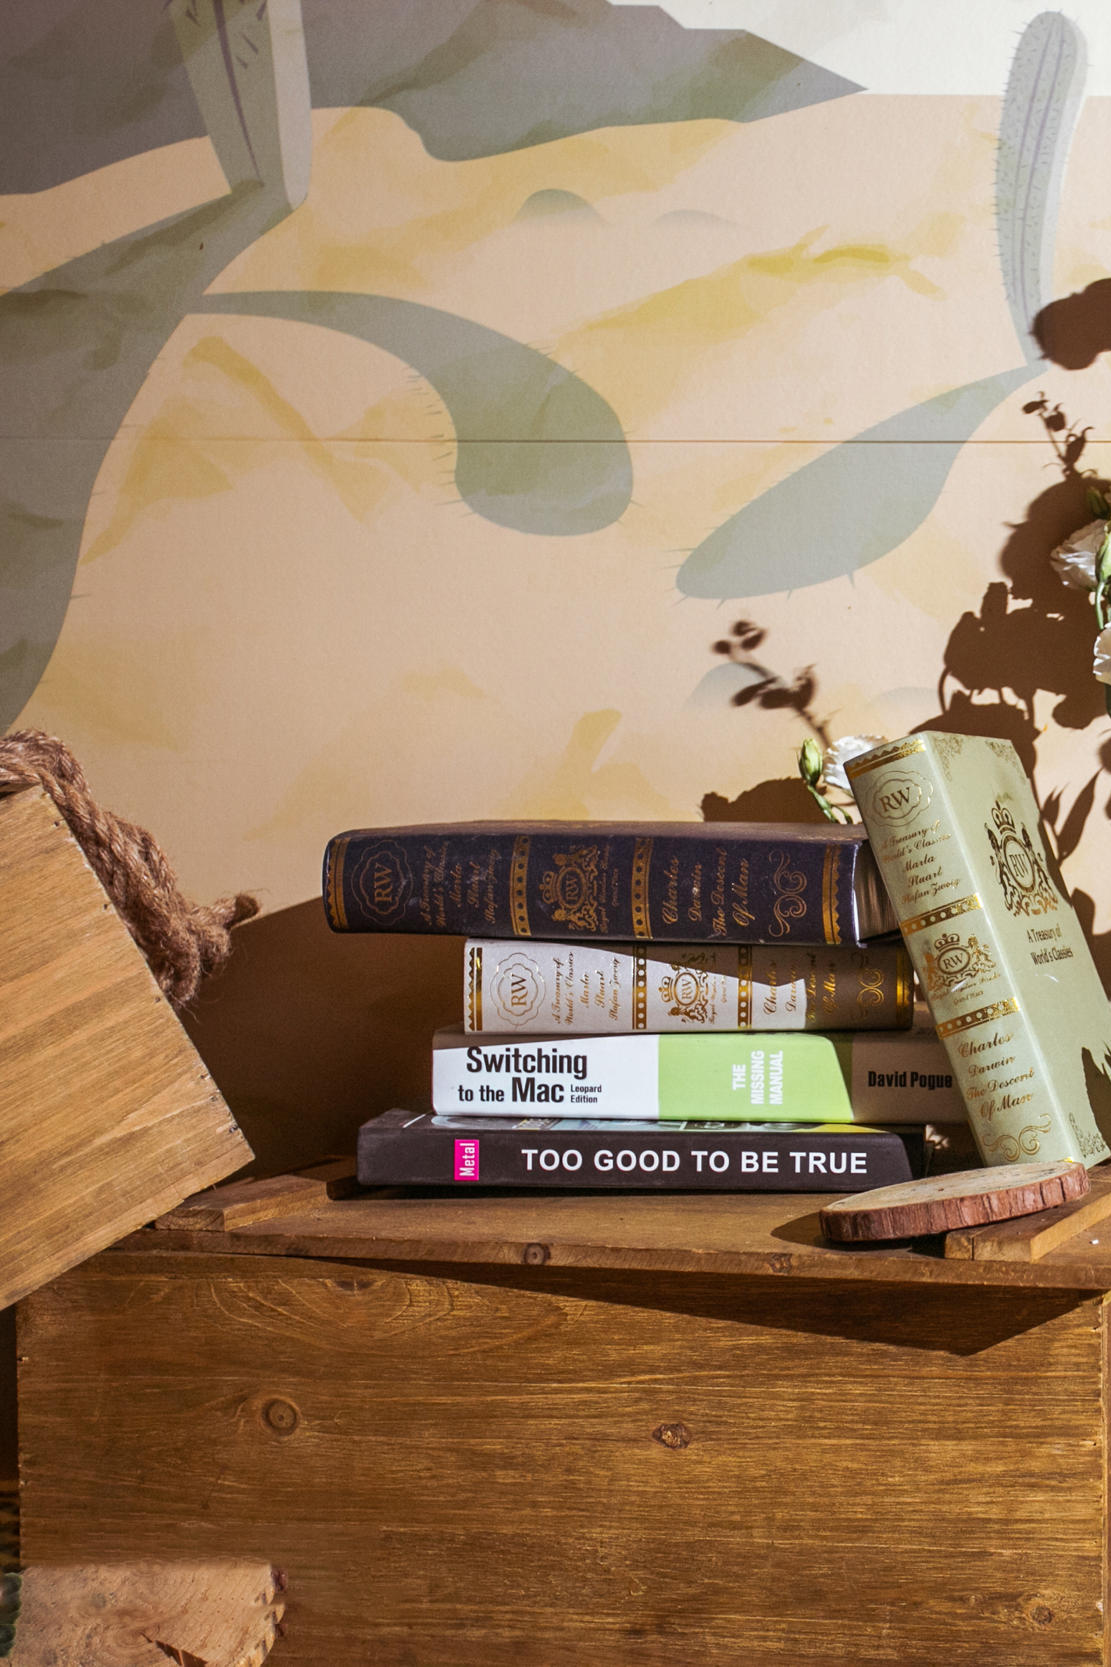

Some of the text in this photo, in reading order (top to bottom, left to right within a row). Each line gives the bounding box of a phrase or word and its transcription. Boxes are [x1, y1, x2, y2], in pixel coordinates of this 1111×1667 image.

[879, 787, 911, 814] RW
[890, 827, 927, 847] Treasury
[711, 848, 727, 905] Descent
[1010, 849, 1029, 878] RW
[373, 862, 394, 904] RW
[566, 875, 578, 900] RW
[662, 856, 678, 924] Charles
[688, 863, 702, 922] Darwin
[732, 858, 755, 926] Of Man
[713, 907, 727, 936] The
[942, 953, 963, 969] RW
[511, 974, 529, 1007] RW
[681, 979, 692, 1000] RW
[763, 960, 777, 1015] Charles
[958, 1032, 1013, 1057] Charles
[466, 1046, 587, 1079] Switching
[732, 1064, 746, 1090] THE
[751, 1050, 764, 1104] MISSING
[968, 1056, 1016, 1078] Darwin
[458, 1077, 564, 1102] to the Mac
[570, 1085, 602, 1094] Leopard
[770, 1050, 783, 1105] MANUAL
[868, 1072, 952, 1090] David Pogue
[967, 1067, 1034, 1100] The Descent
[570, 1095, 598, 1103] Edition
[979, 1092, 1034, 1121] Of Man
[459, 1143, 475, 1177] Metal
[521, 1149, 867, 1174] TOO GOOD TO BE TRUE
